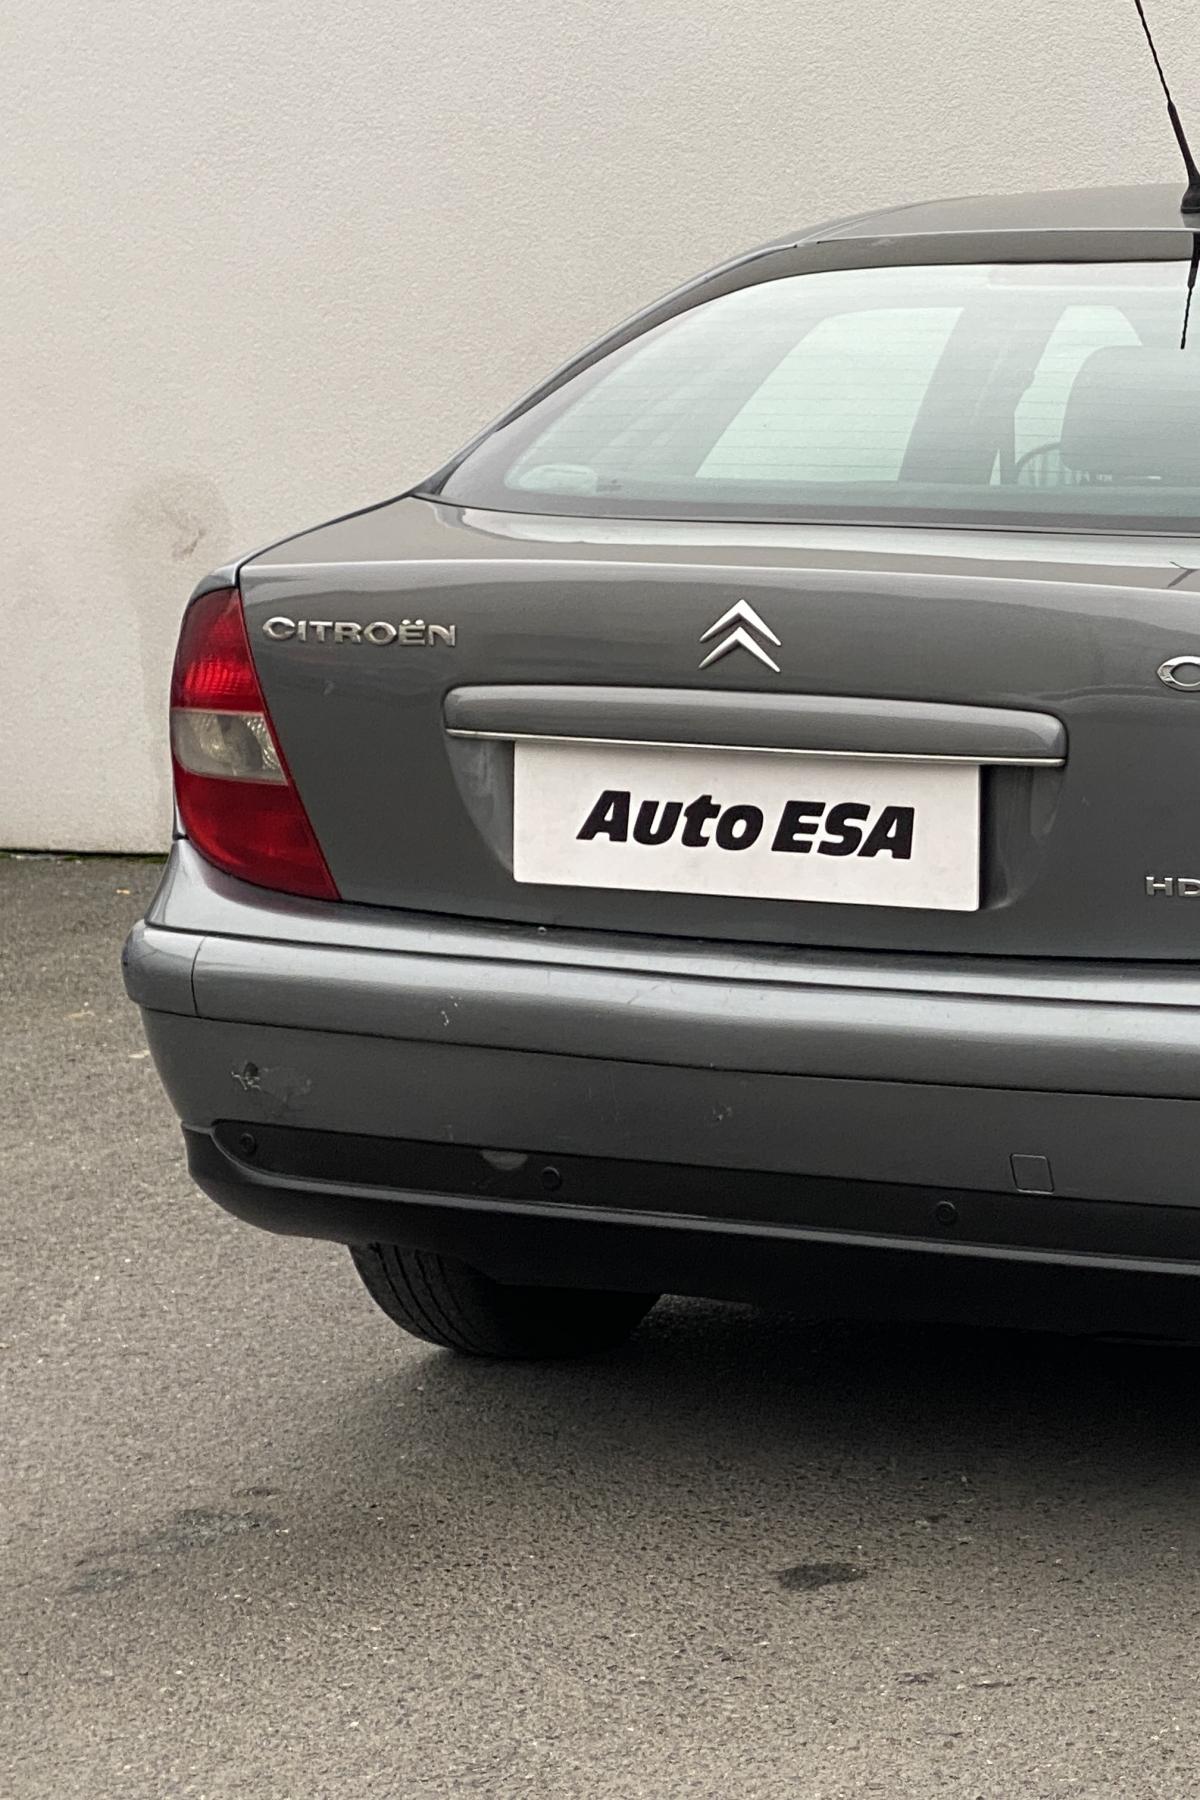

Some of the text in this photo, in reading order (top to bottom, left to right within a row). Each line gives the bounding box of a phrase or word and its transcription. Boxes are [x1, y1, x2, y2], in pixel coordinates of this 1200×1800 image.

[262, 615, 456, 647] CITROËN
[576, 790, 915, 860] Auto ESA
